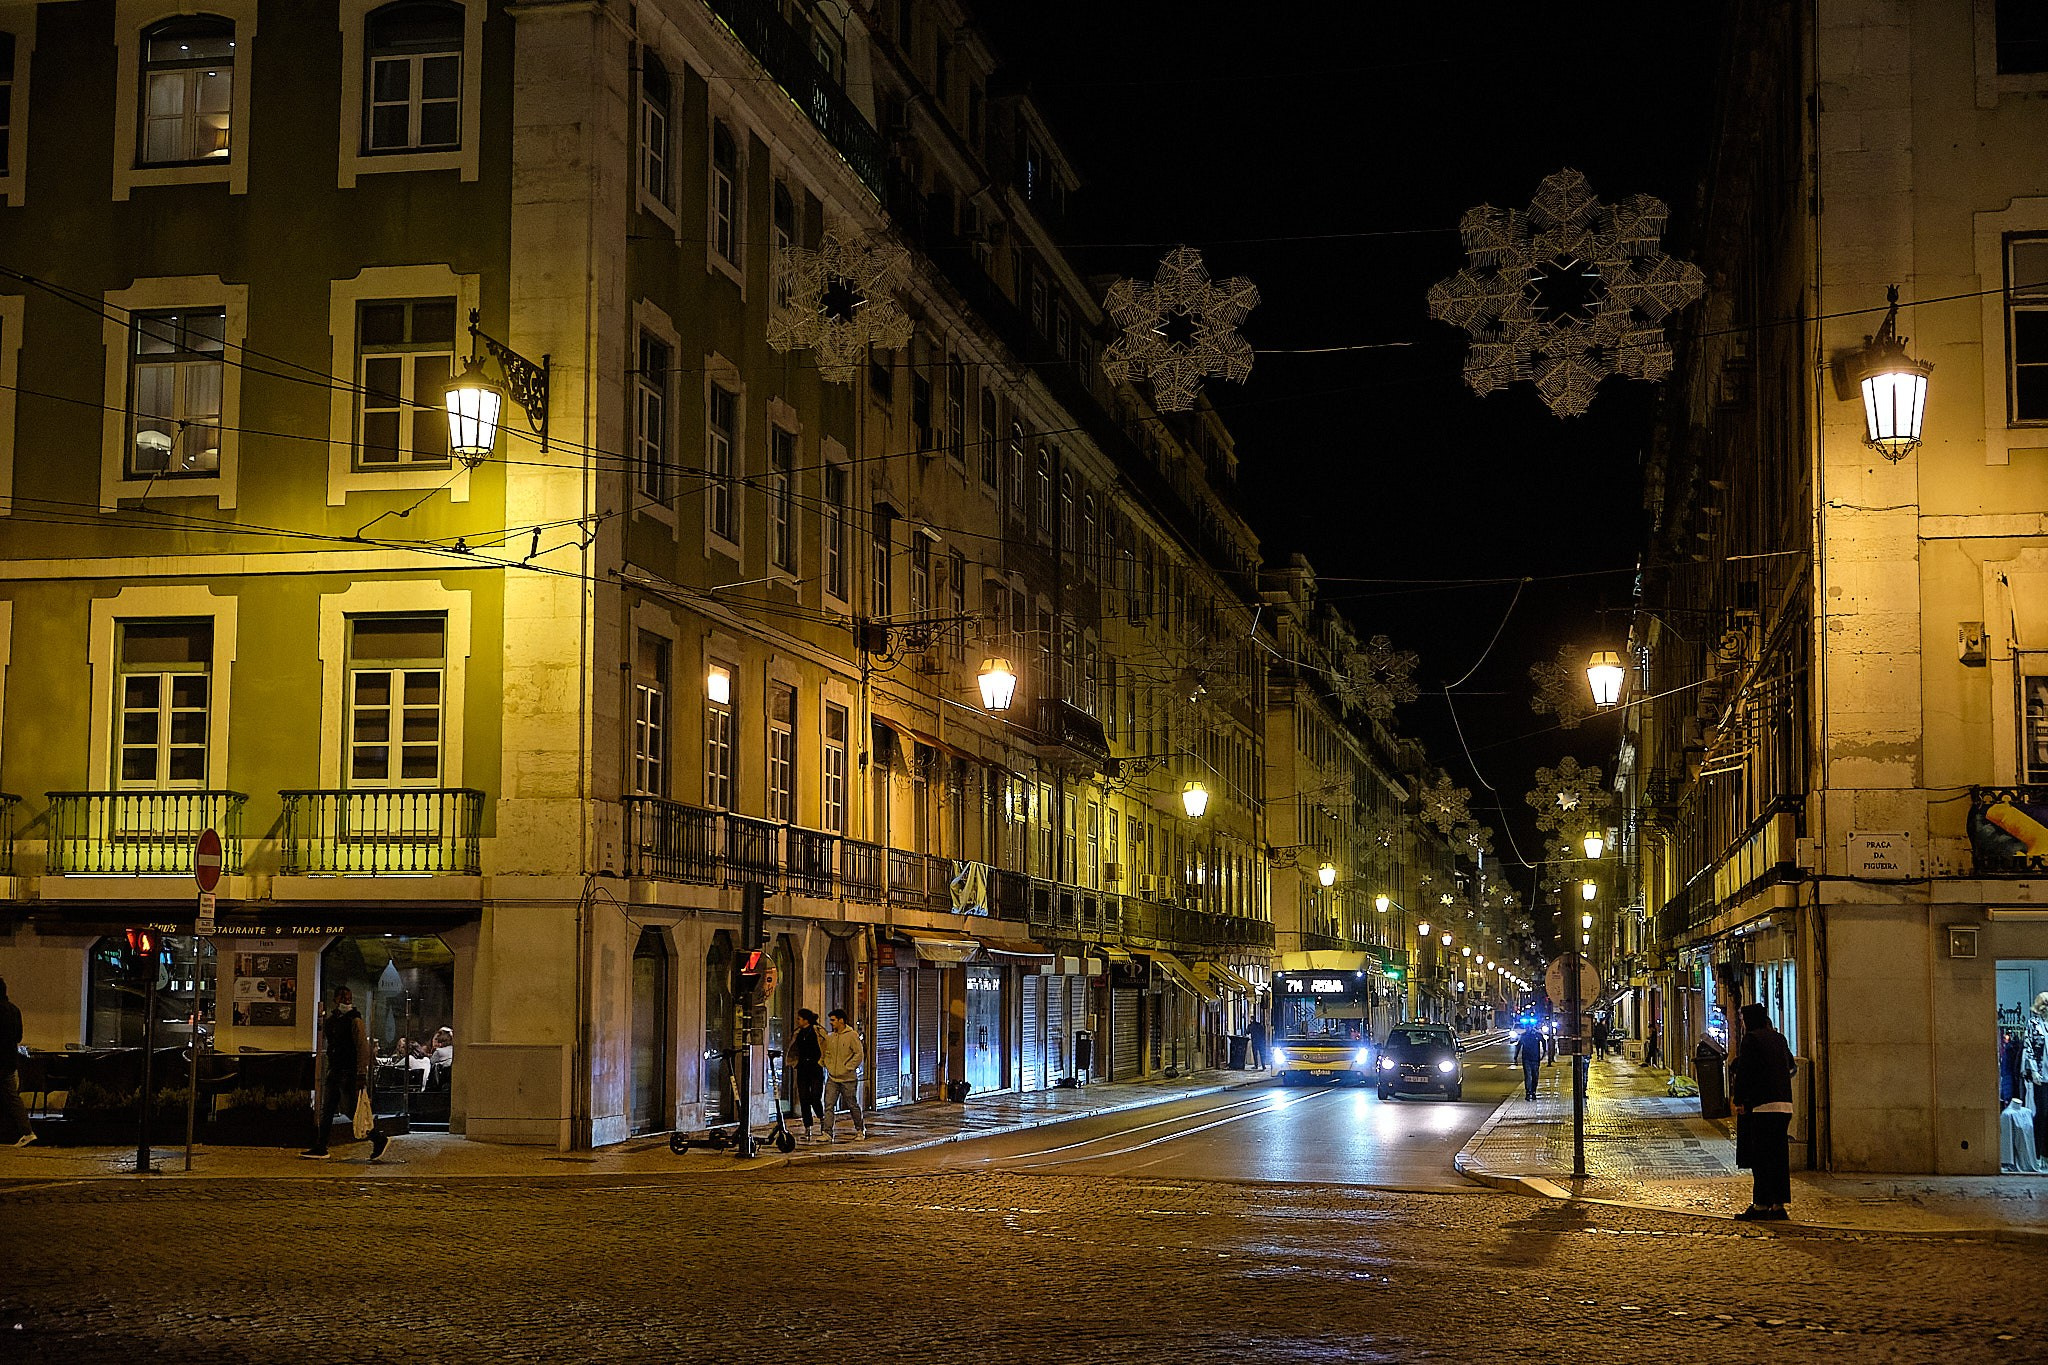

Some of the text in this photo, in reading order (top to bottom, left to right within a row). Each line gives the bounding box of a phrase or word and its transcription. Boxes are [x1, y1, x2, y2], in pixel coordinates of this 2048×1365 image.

[1863, 862, 1898, 870] FIGUEIRA
[212, 926, 267, 935] STAURANTE
[292, 926, 321, 934] TAPAS
[325, 926, 345, 934] BAR
